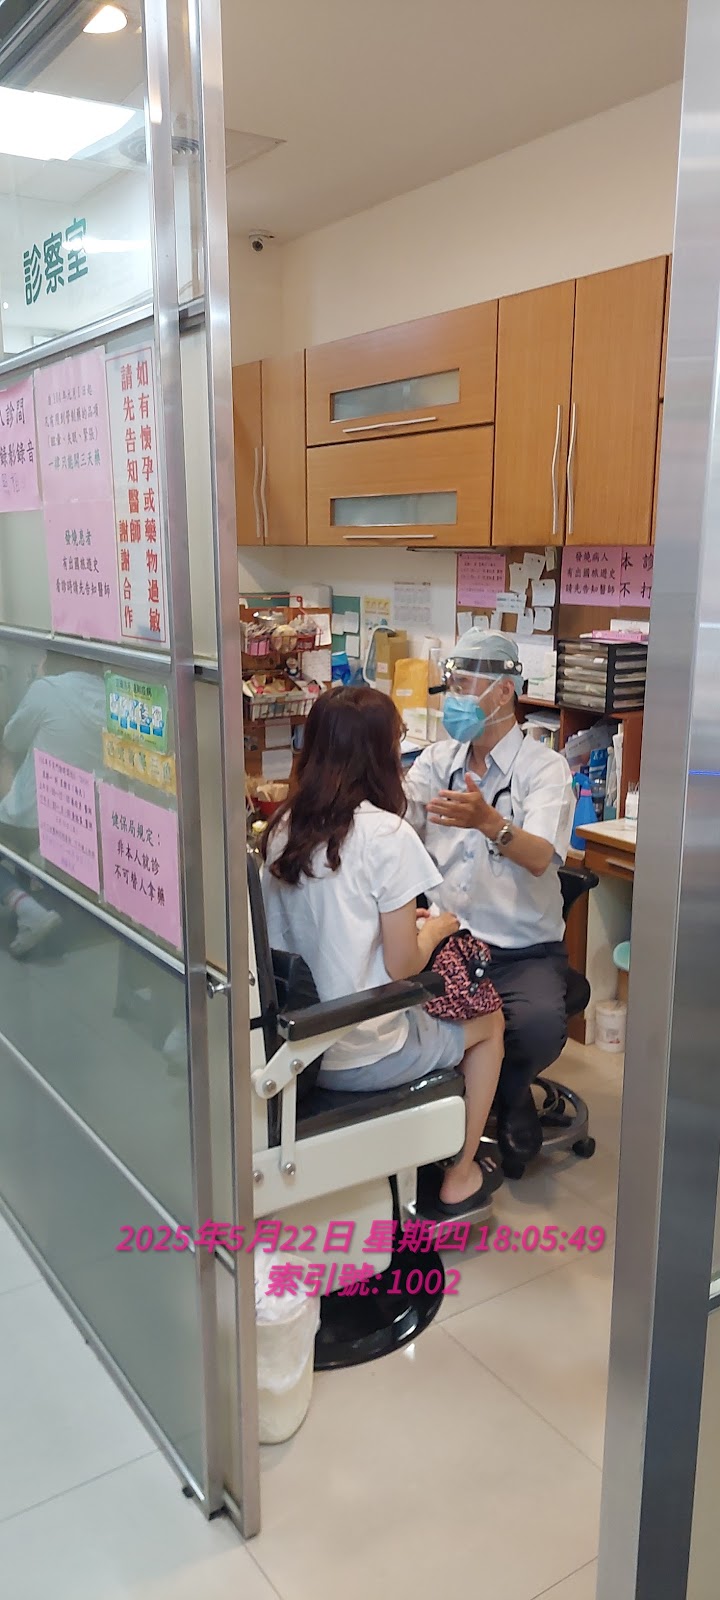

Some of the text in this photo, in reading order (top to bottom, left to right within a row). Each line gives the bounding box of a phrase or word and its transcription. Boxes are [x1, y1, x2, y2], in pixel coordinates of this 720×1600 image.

[23, 217, 89, 306] 診察室
[121, 363, 141, 543] 請先告知醫師
[136, 361, 161, 633] 如有懷孕或藥物過敏
[119, 519, 133, 629] 謝謝合作
[114, 863, 166, 907] 不可替人拿藥
[117, 839, 160, 876] 非本人就診
